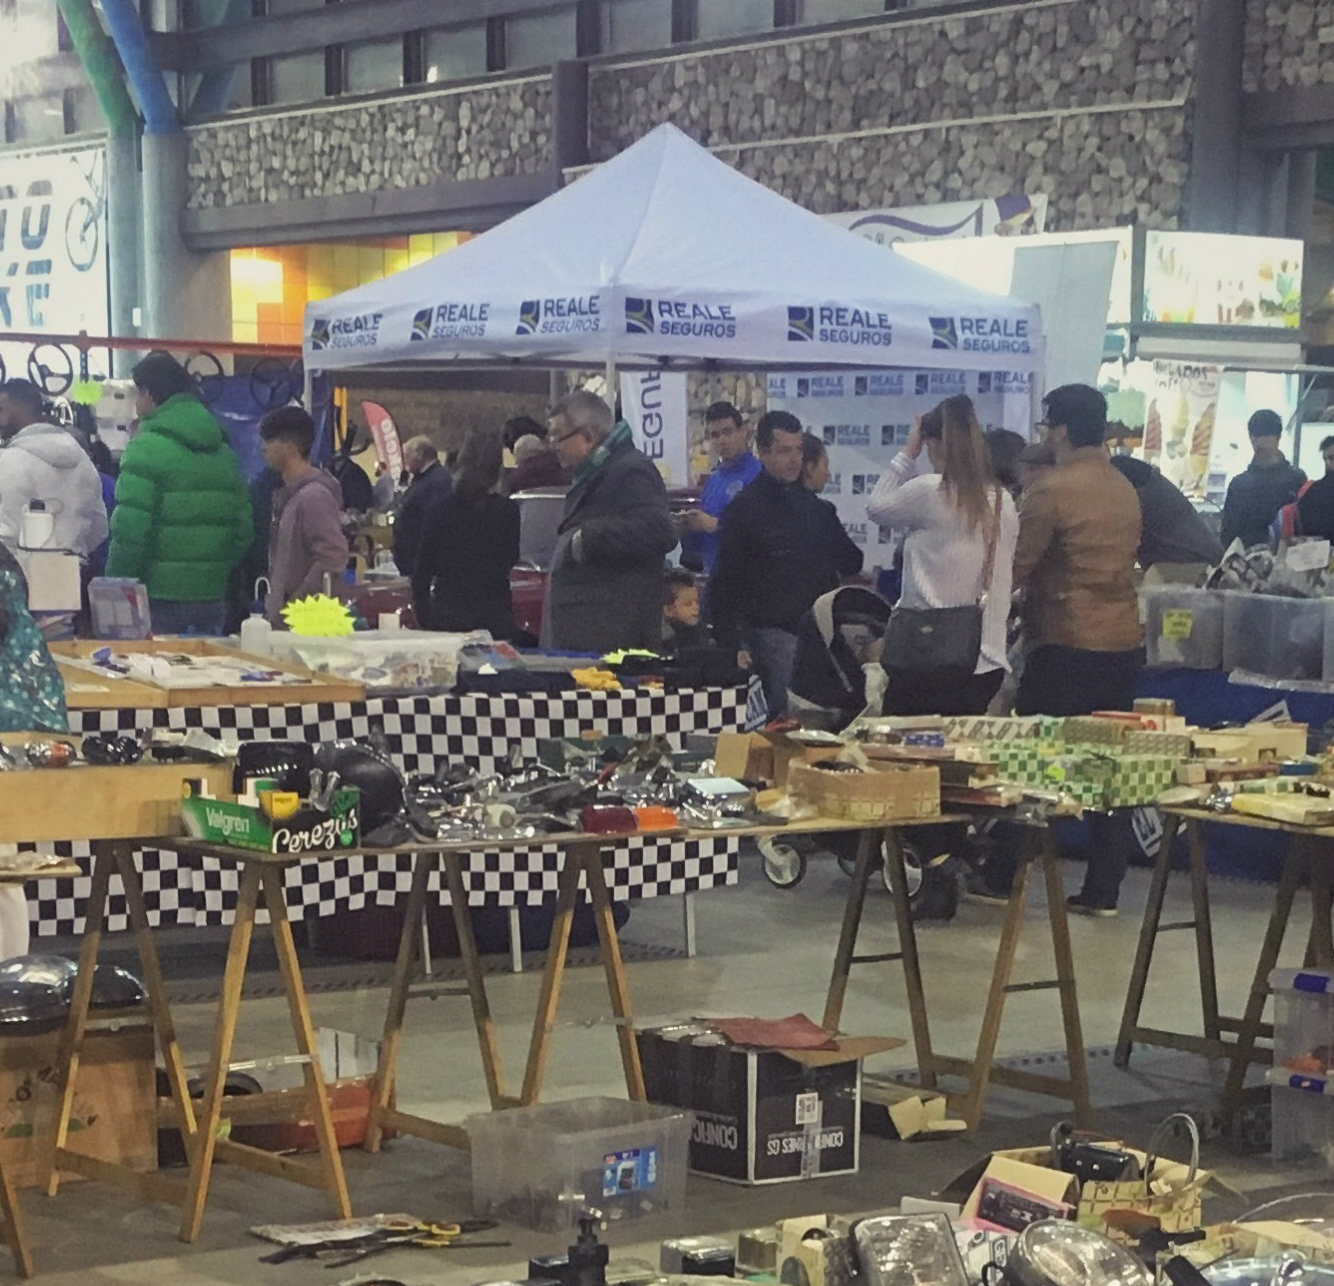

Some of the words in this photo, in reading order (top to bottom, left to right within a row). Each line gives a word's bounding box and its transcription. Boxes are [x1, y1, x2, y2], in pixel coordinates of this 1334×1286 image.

[435, 303, 490, 322] REALE
[543, 295, 600, 317] REALE
[657, 300, 736, 320] REALE
[331, 313, 383, 334] REALE
[540, 317, 600, 333] SEGUROS
[819, 307, 892, 330] REALE
[960, 317, 1028, 338] REALE
[432, 323, 486, 338] SEGUROS
[660, 320, 736, 338] SEGUROS
[819, 327, 892, 347] SEGUROS
[330, 333, 378, 349] SEGUROS
[962, 338, 1030, 354] SEGUROS
[811, 376, 844, 389] REALE
[870, 374, 904, 388] REALE
[931, 371, 966, 386] REALE
[206, 807, 250, 835] Valgren
